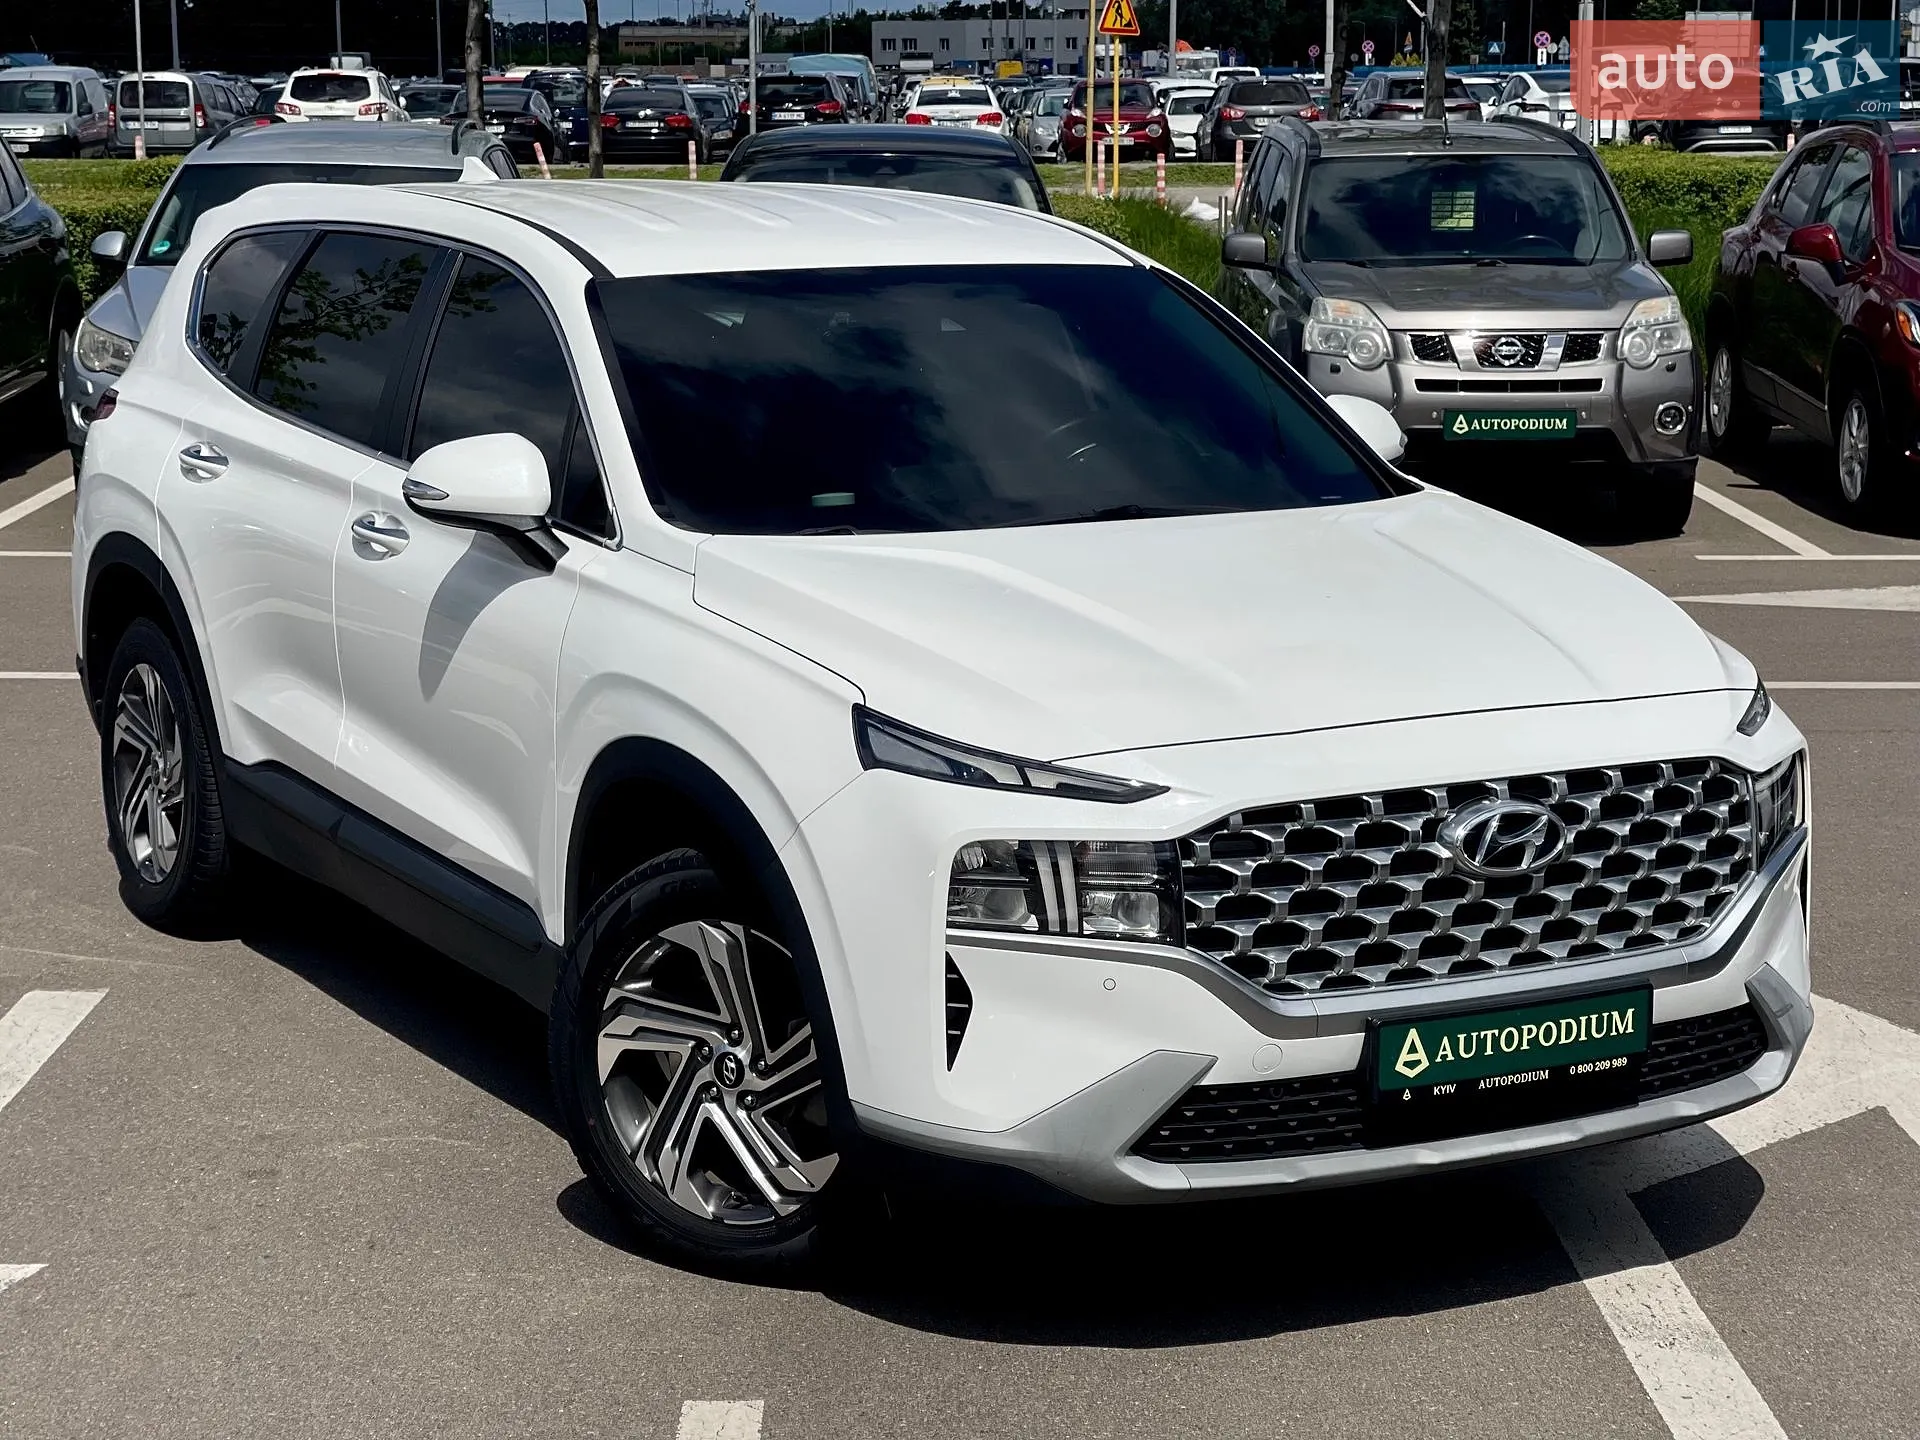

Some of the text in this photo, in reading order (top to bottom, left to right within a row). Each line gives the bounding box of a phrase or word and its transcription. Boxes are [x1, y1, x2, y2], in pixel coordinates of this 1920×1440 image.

[1471, 418, 1568, 430] AUTOPODIUM
[1435, 1008, 1636, 1063] AUTOPODIUM
[1433, 1057, 1628, 1096] KYIV AUTOPODIUM 0 800 209 989
